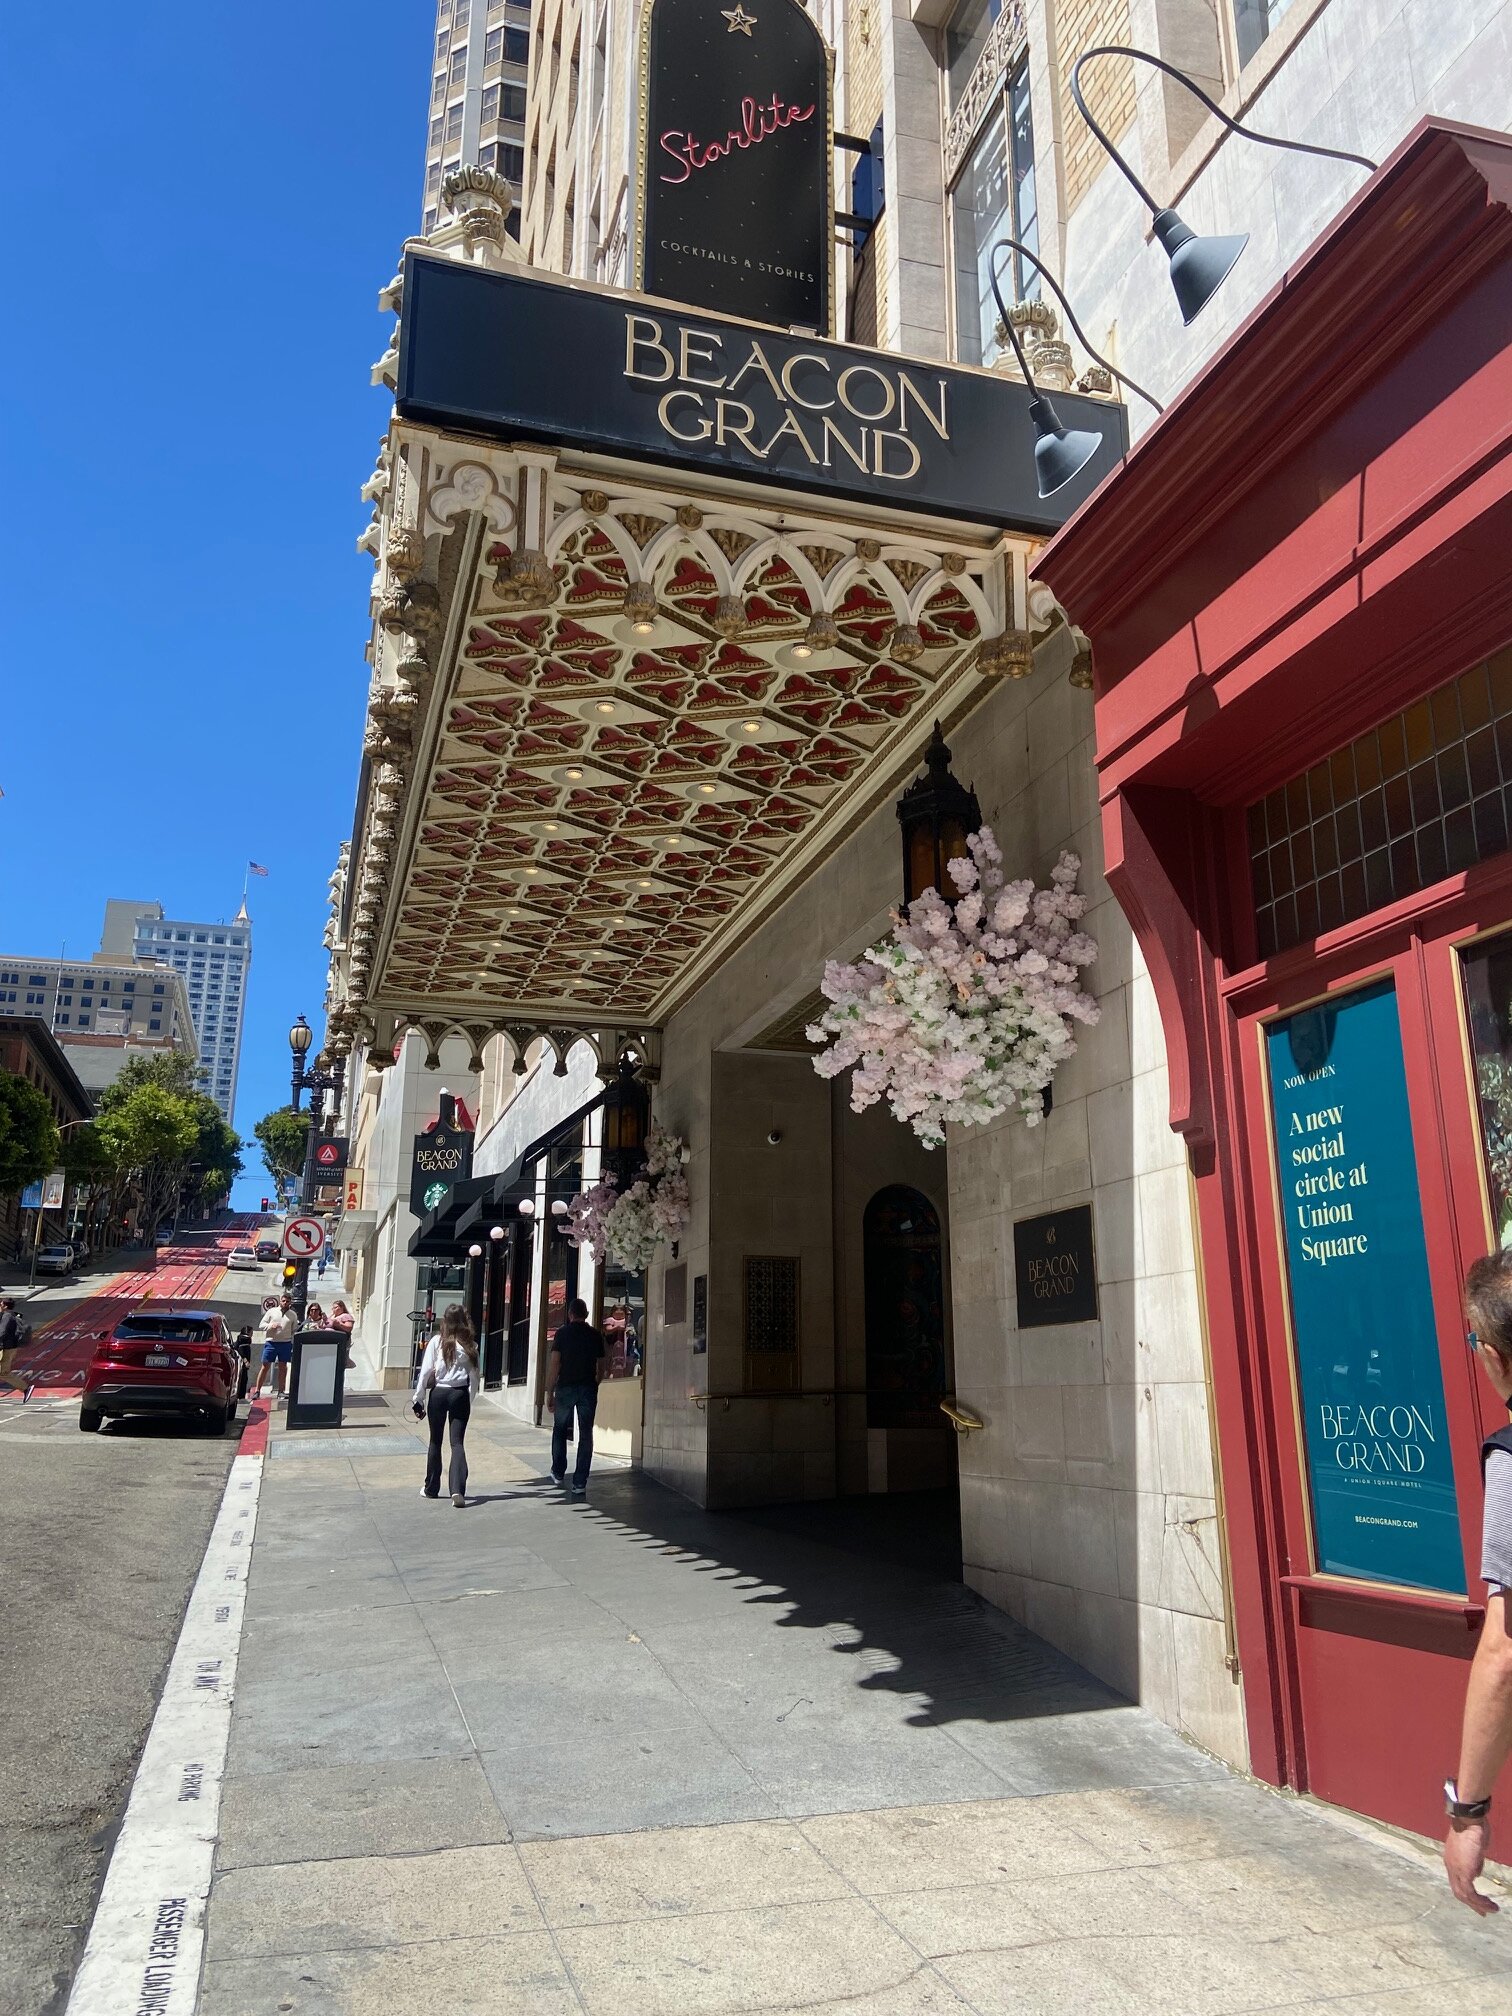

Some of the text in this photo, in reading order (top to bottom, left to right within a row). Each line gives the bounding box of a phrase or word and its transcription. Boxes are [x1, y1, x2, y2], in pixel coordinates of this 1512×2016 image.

[660, 92, 815, 183] Starlite
[661, 240, 814, 283] COCKTAILS & STORIES
[623, 313, 949, 440] BEACON
[658, 390, 921, 480] GRAND
[1284, 1063, 1336, 1090] NOW OPEN
[1289, 1105, 1344, 1136] A new
[417, 1148, 463, 1162] BEACON
[1292, 1131, 1345, 1166] social
[421, 1160, 458, 1171] GRAND
[1295, 1161, 1368, 1197] circle at
[1298, 1201, 1353, 1229] Union
[1301, 1234, 1368, 1266] Square
[1028, 1252, 1079, 1282] BEACON
[1034, 1276, 1075, 1299] GRAND
[1320, 1405, 1435, 1442] BEACON
[1336, 1441, 1424, 1472] GRAND
[1355, 1515, 1418, 1529] BEACONGRAND.COM
[178, 1763, 204, 1801] NO PARKING
[136, 1898, 187, 2016] PASSENGER LOADING
